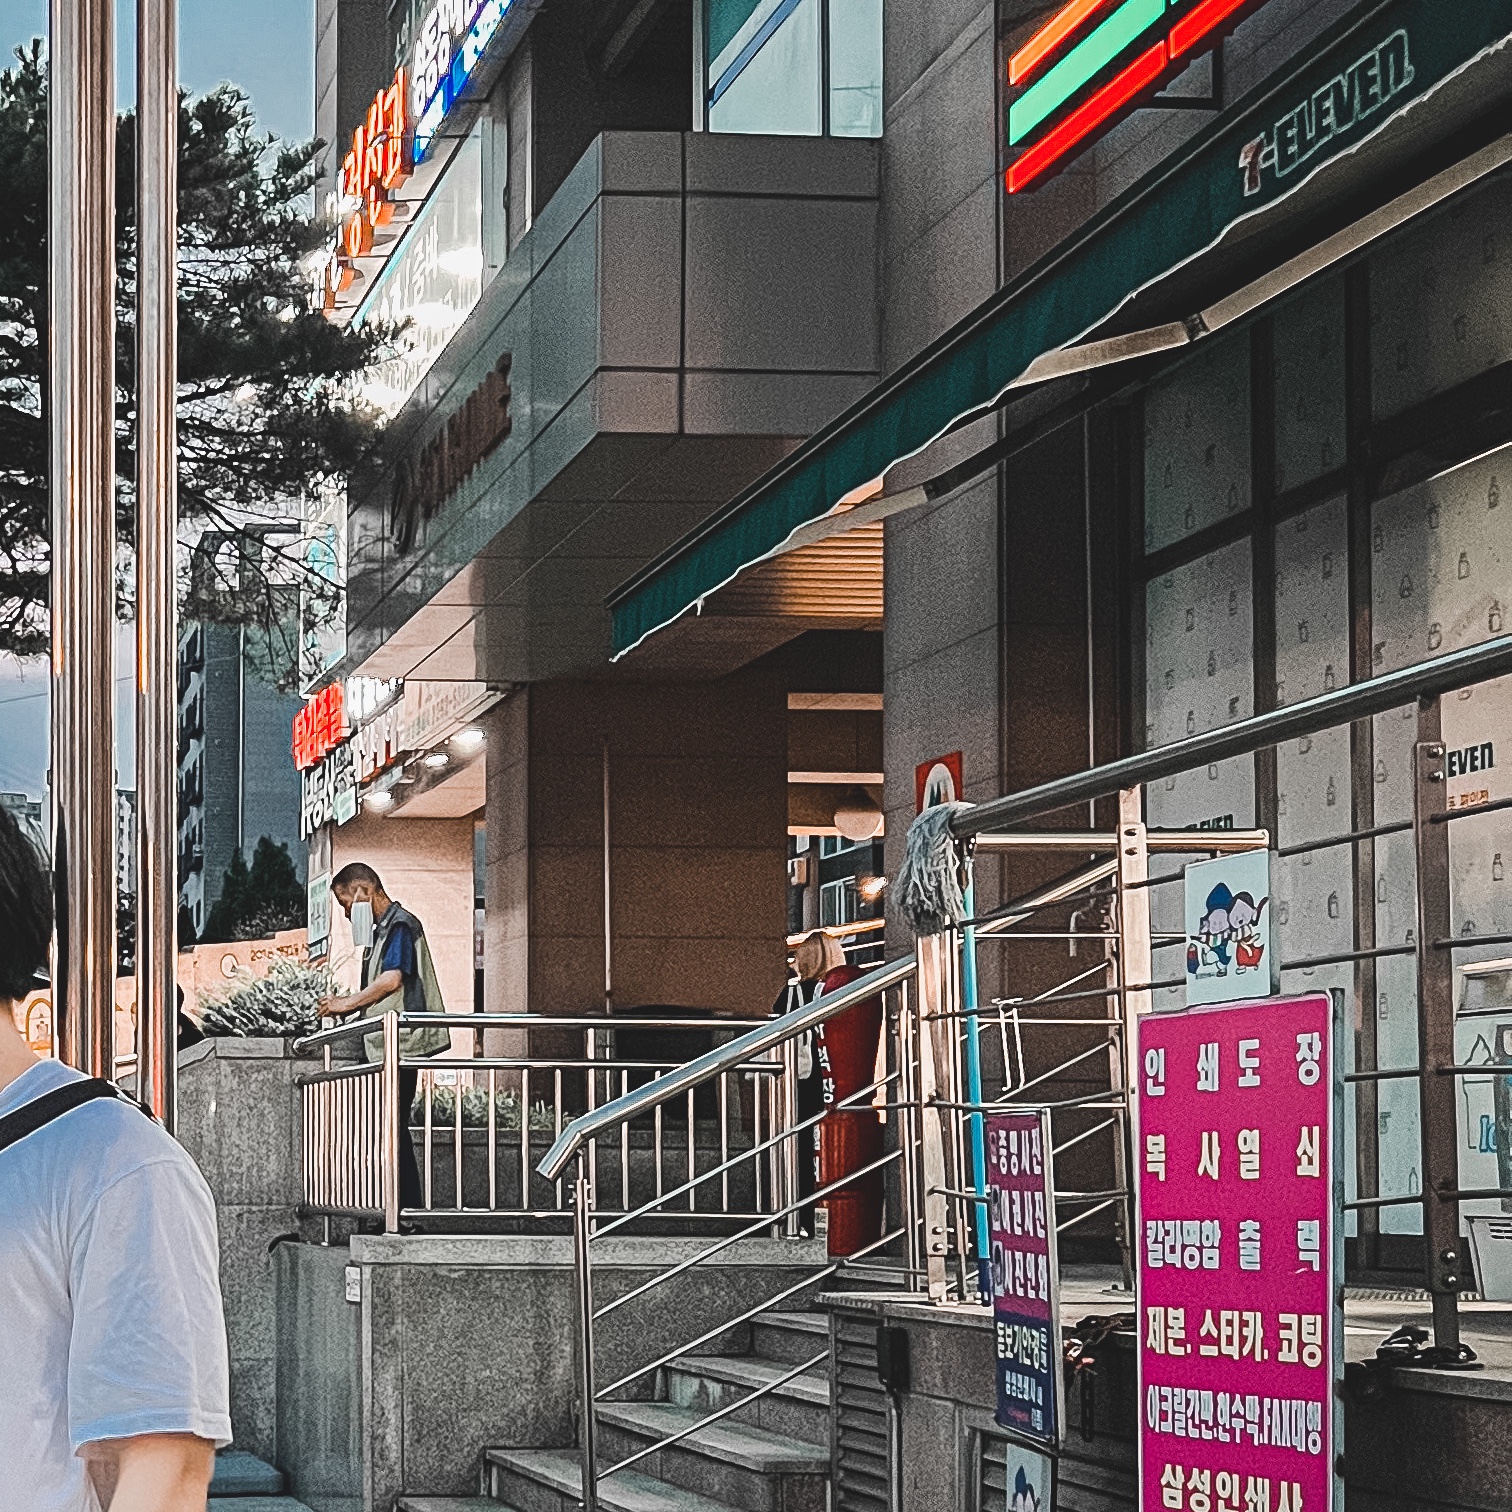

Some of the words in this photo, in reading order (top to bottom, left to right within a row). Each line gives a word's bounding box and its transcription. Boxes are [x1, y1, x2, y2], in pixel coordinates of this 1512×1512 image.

[1144, 1042, 1220, 1096] 인쇄
[1238, 1031, 1322, 1087] 도장
[1146, 1131, 1221, 1182] 복사
[1237, 1125, 1320, 1179] 열쇠
[1238, 1219, 1320, 1272] 출력
[1277, 1313, 1323, 1368] 코팅
